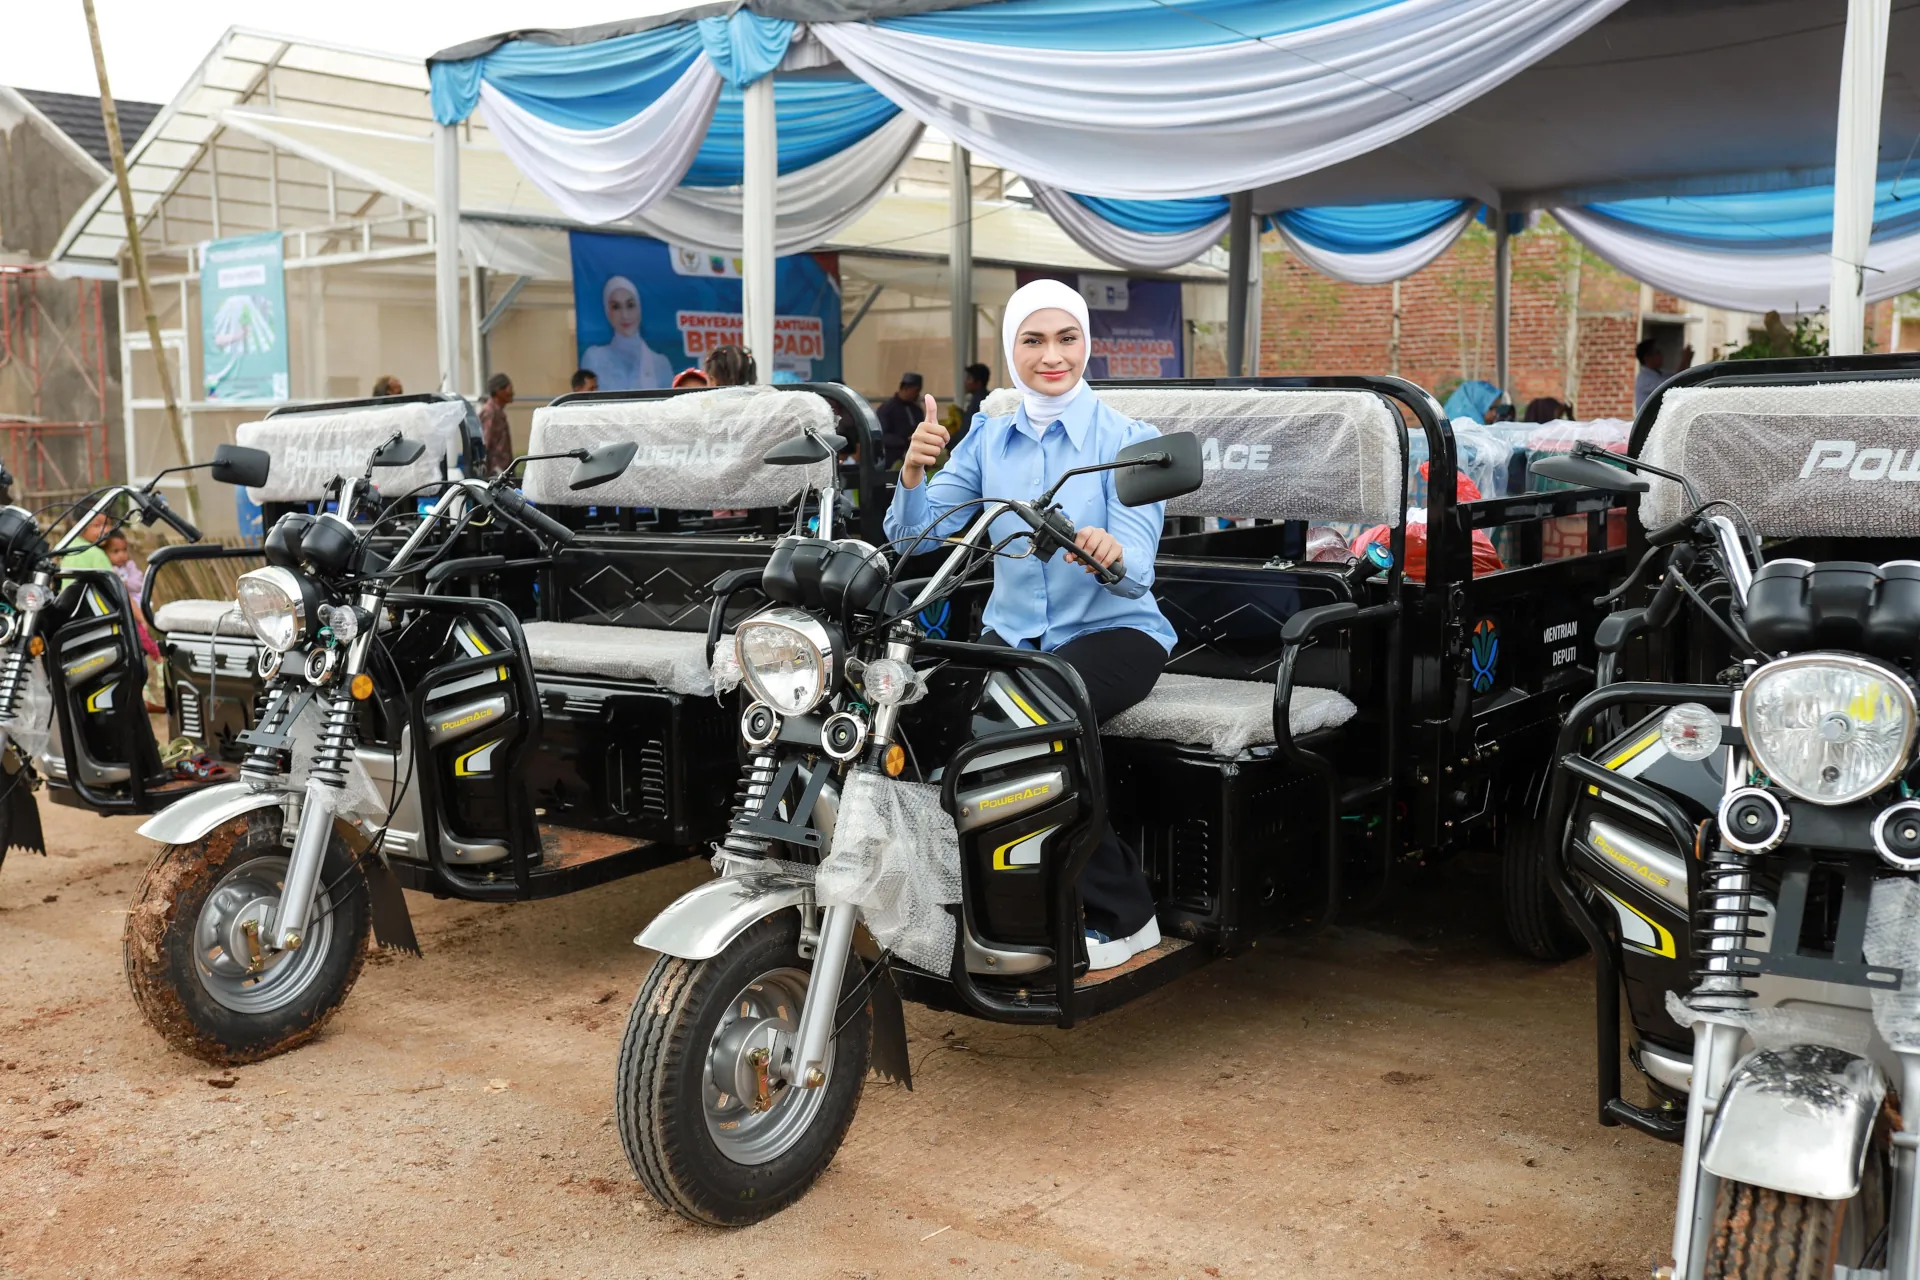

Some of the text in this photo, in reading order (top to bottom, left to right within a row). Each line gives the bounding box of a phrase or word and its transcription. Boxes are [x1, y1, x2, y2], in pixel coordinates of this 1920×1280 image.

[680, 315, 820, 331] PENYERAH ANTUAN
[686, 330, 822, 356] BENI PADI
[1091, 339, 1174, 357] DALAM MASA
[1109, 356, 1160, 376] RESES
[1552, 645, 1577, 667] DEPUTI
